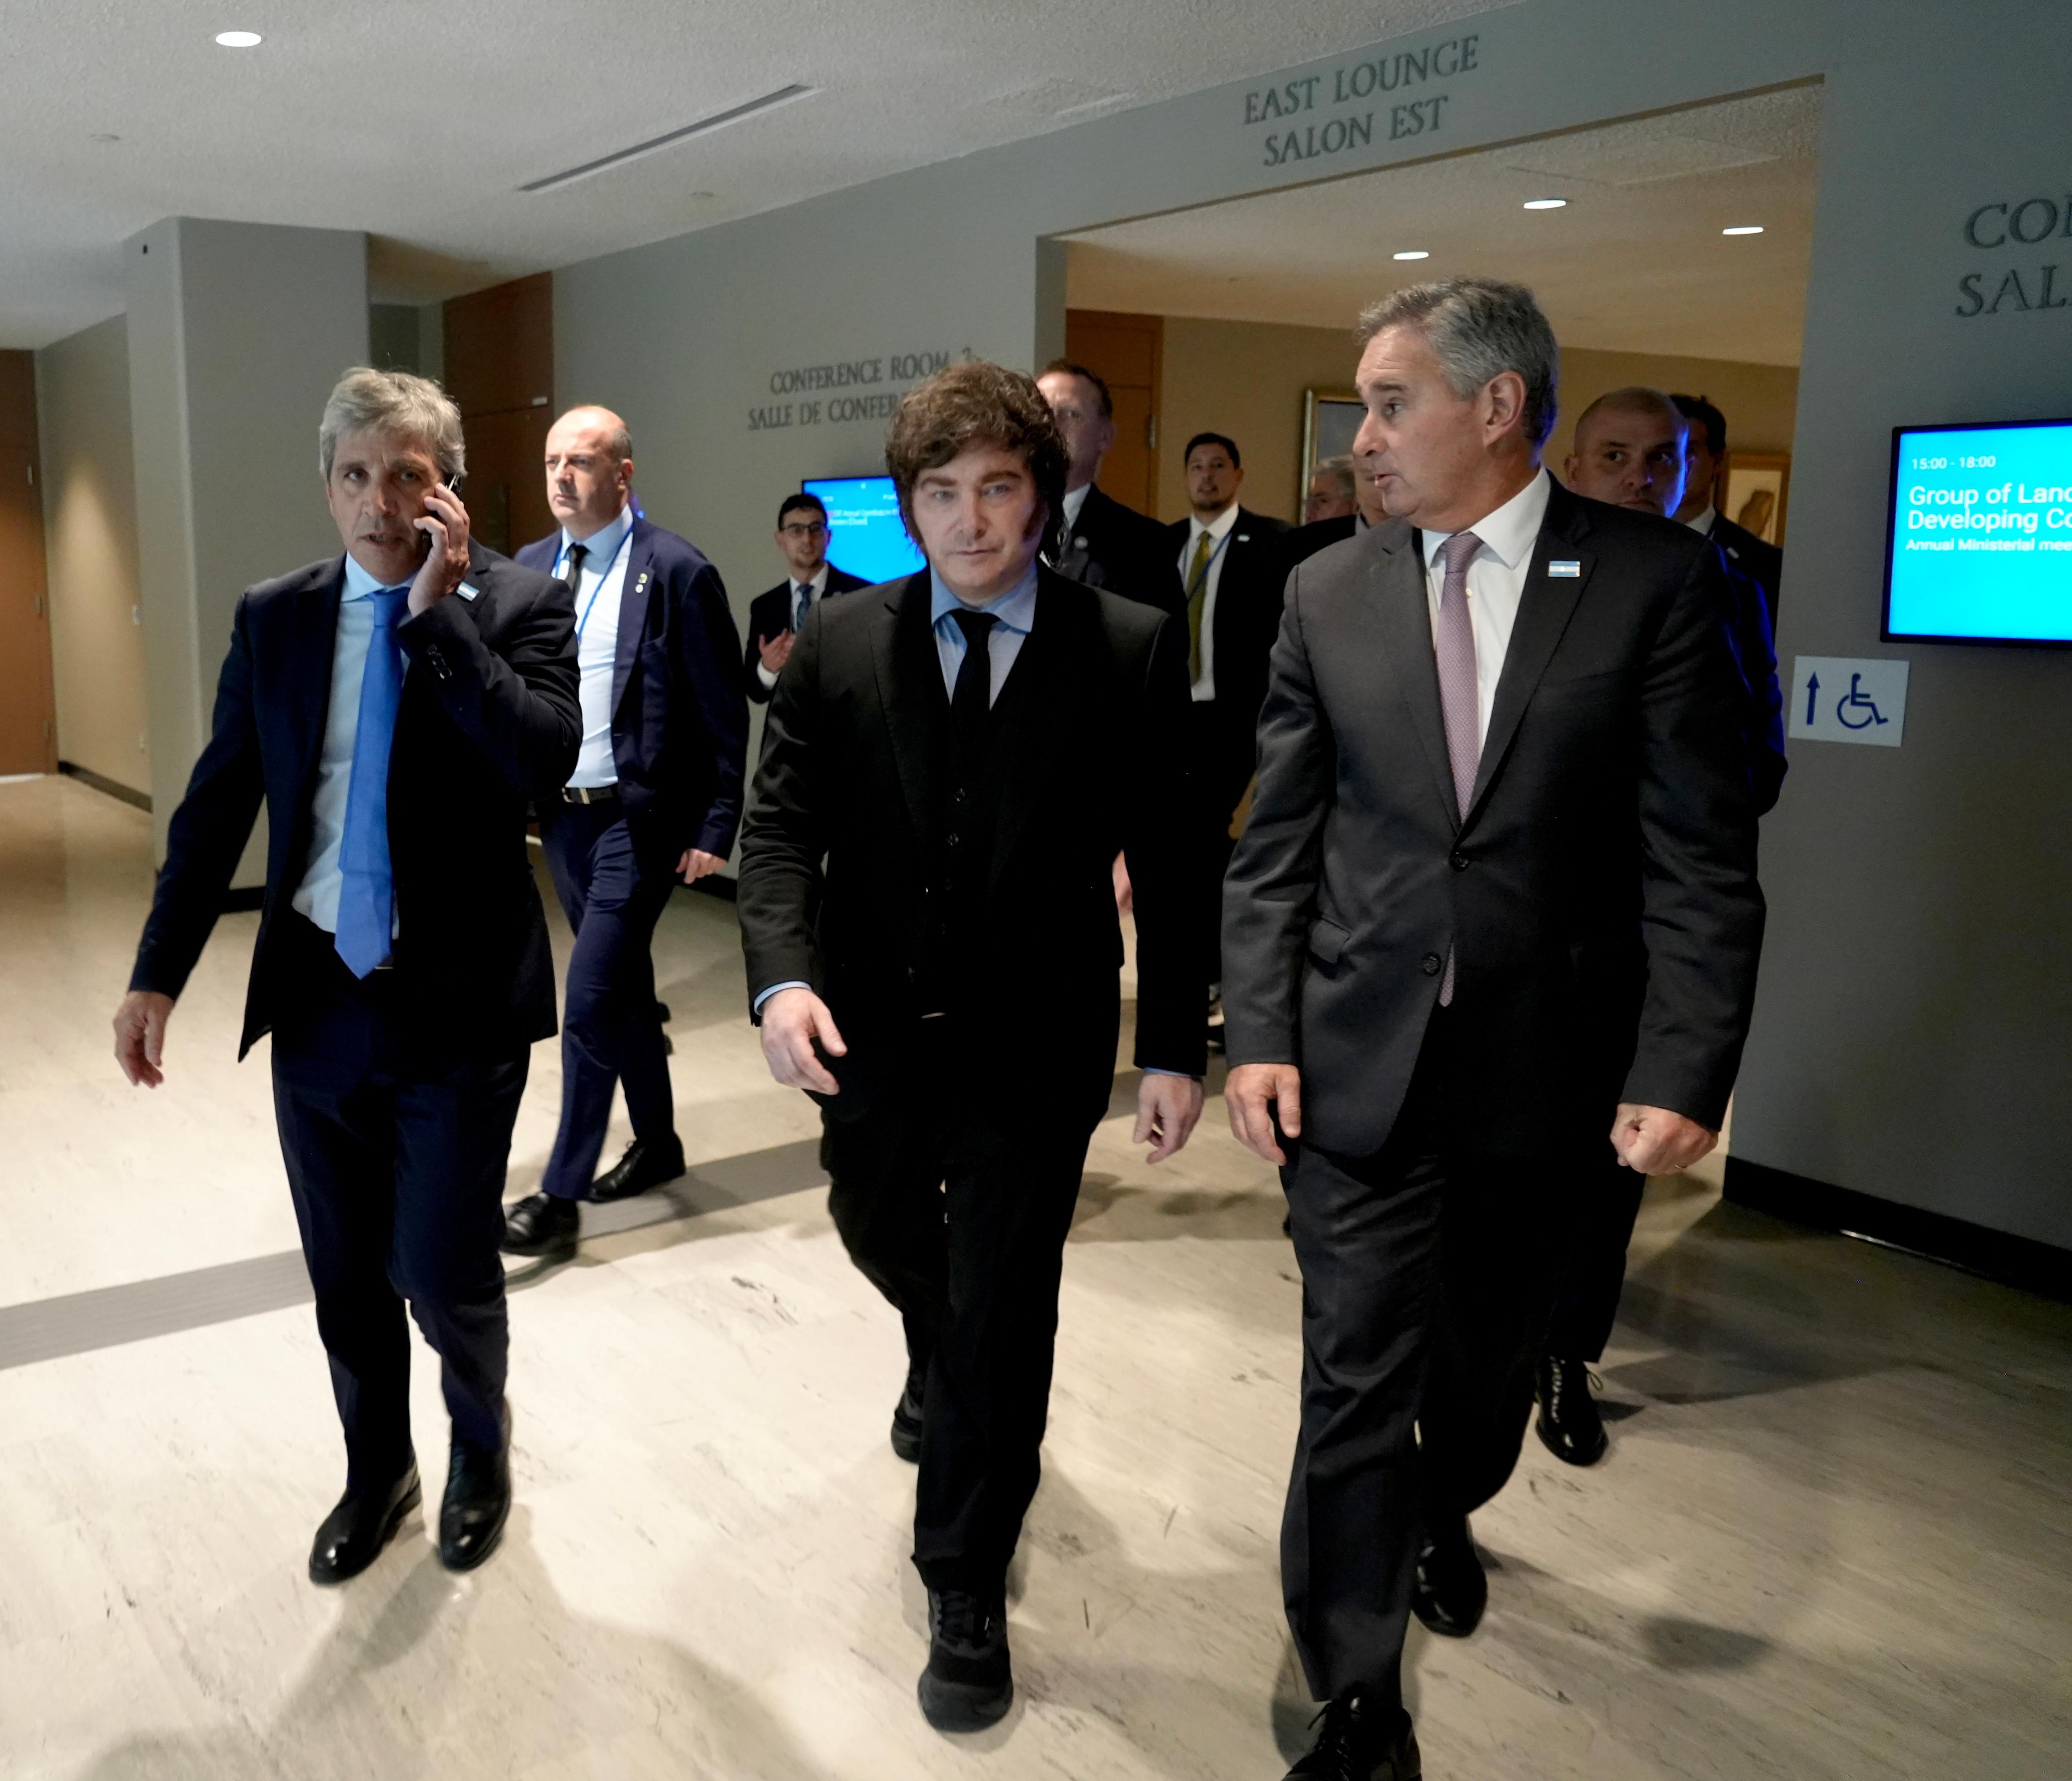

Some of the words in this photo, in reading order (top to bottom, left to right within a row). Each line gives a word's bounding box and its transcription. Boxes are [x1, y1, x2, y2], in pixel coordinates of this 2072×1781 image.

[1244, 77, 1320, 125] EAST
[1332, 35, 1479, 104] LOUNGE
[1264, 113, 1373, 166] SALON
[1389, 95, 1448, 140] EST
[1955, 265, 2072, 317] SAL
[770, 358, 882, 395] CONFERENCE
[890, 351, 949, 381] ROOM
[748, 404, 793, 430] SALLE
[799, 401, 821, 425] DE
[828, 392, 907, 422] CONFER
[1912, 457, 1947, 470] 15:00
[1958, 455, 1996, 468] 18:00
[1909, 485, 1979, 508] Group
[1985, 482, 2013, 504] of
[1907, 508, 2039, 534] Developing
[1905, 538, 1954, 551] Annual
[1958, 538, 2036, 551] Ministerial
